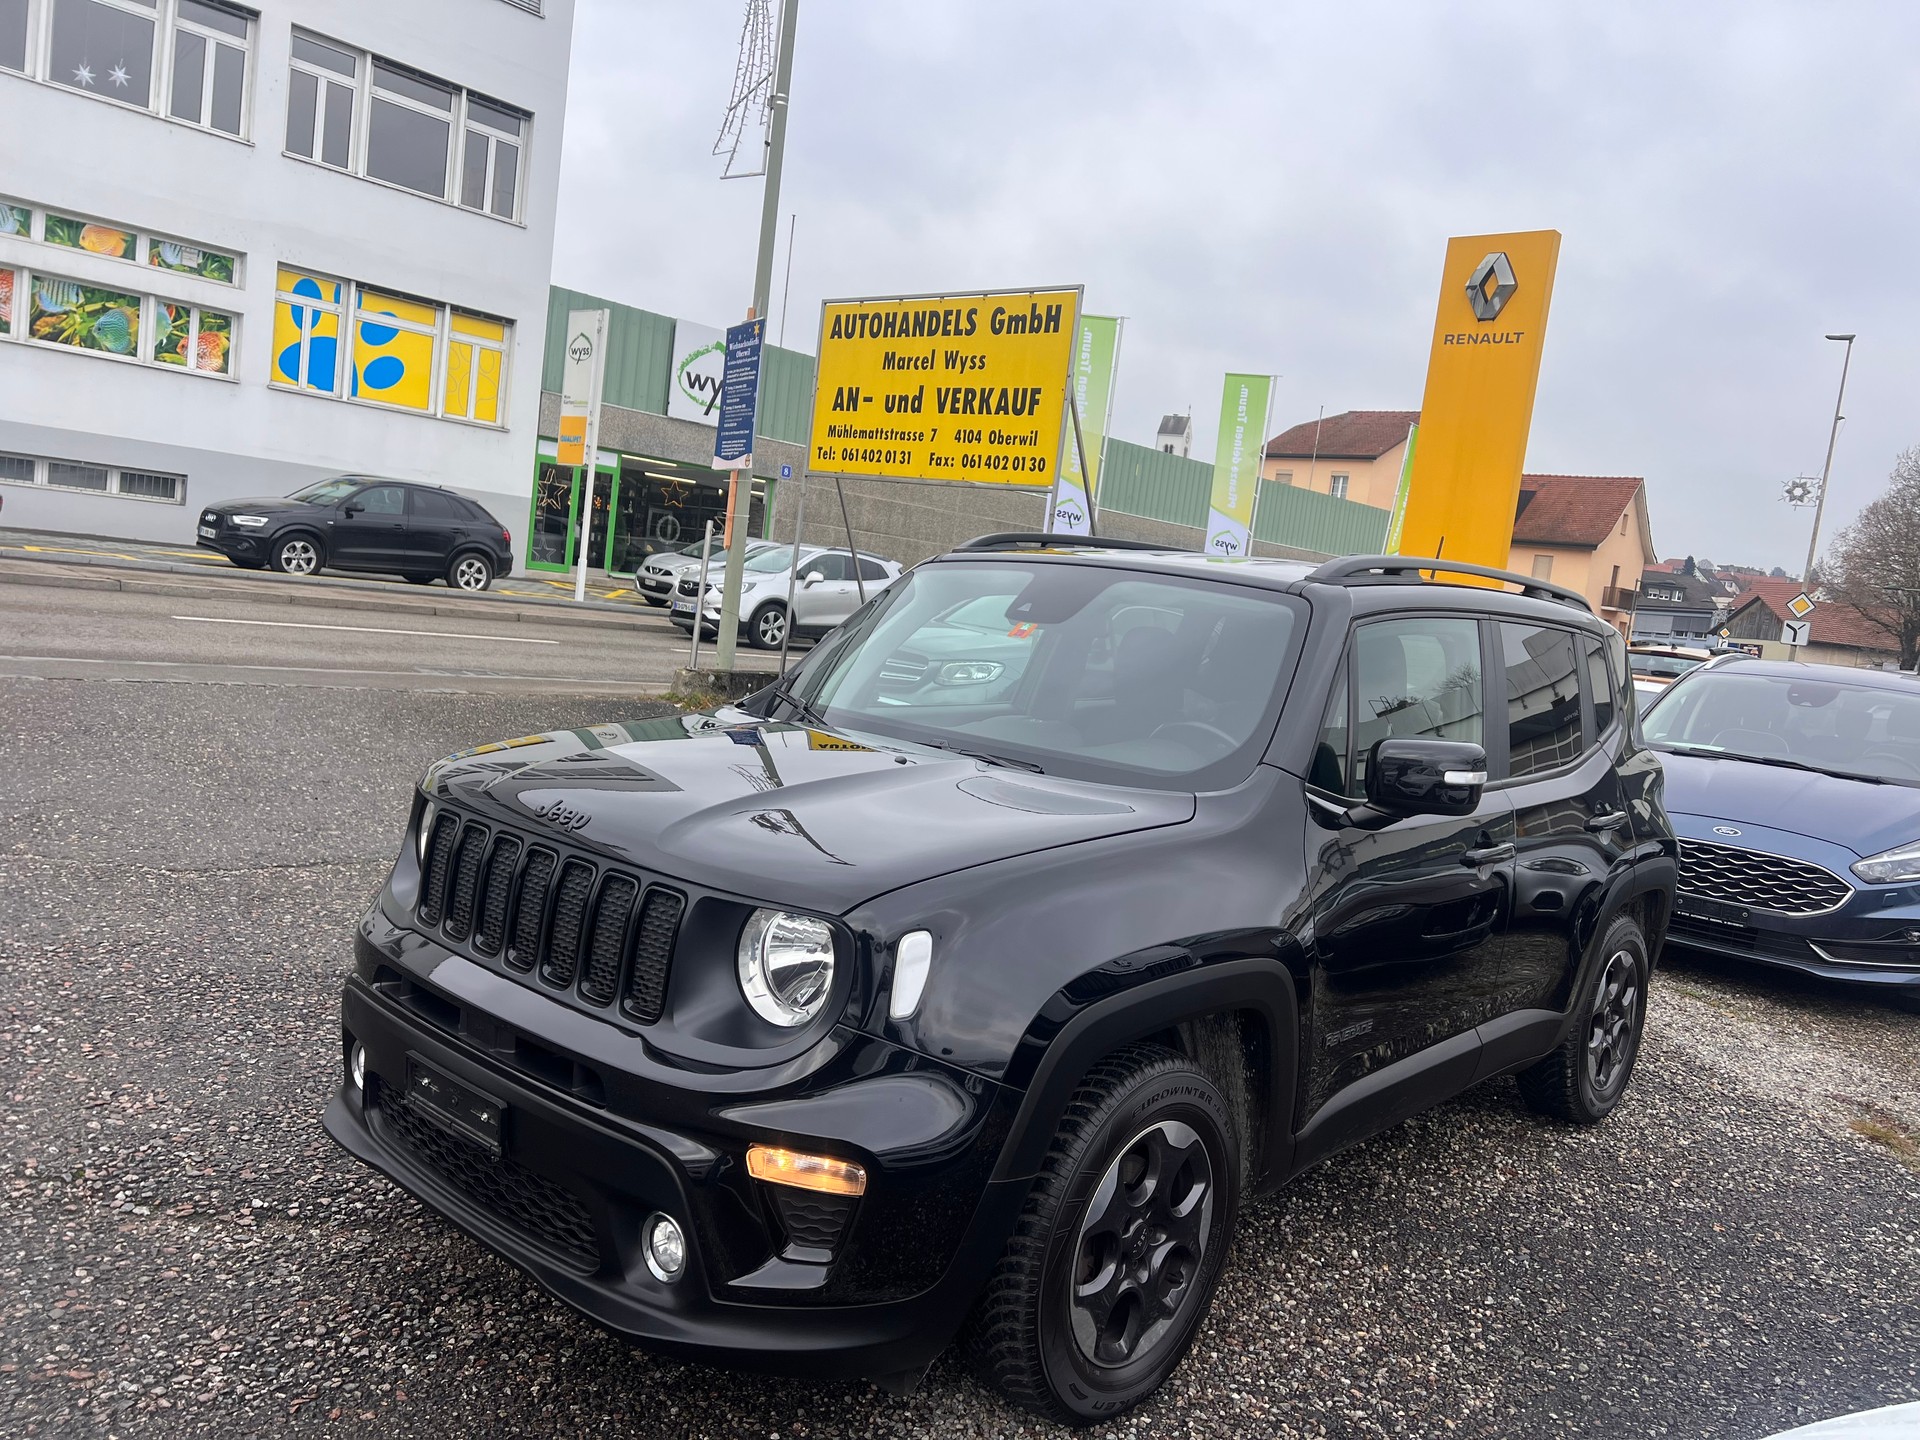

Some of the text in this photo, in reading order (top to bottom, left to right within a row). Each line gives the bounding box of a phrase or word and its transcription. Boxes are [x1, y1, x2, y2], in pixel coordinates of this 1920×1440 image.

[830, 303, 1063, 340] AUTOHANDELS GmbH
[1443, 331, 1525, 345] RENAULT
[571, 347, 590, 366] wyss
[882, 349, 987, 375] Marcel Wyss
[686, 371, 724, 416] wy
[832, 385, 1042, 416] AN- und VERKAUF
[827, 424, 1038, 447] Mühlemattstrasse 7 4104 Oberwil
[817, 446, 836, 461] Tel:
[929, 452, 955, 468] Fax:
[534, 799, 592, 833] Jeep
[1131, 1086, 1214, 1119] EUROWINTER
